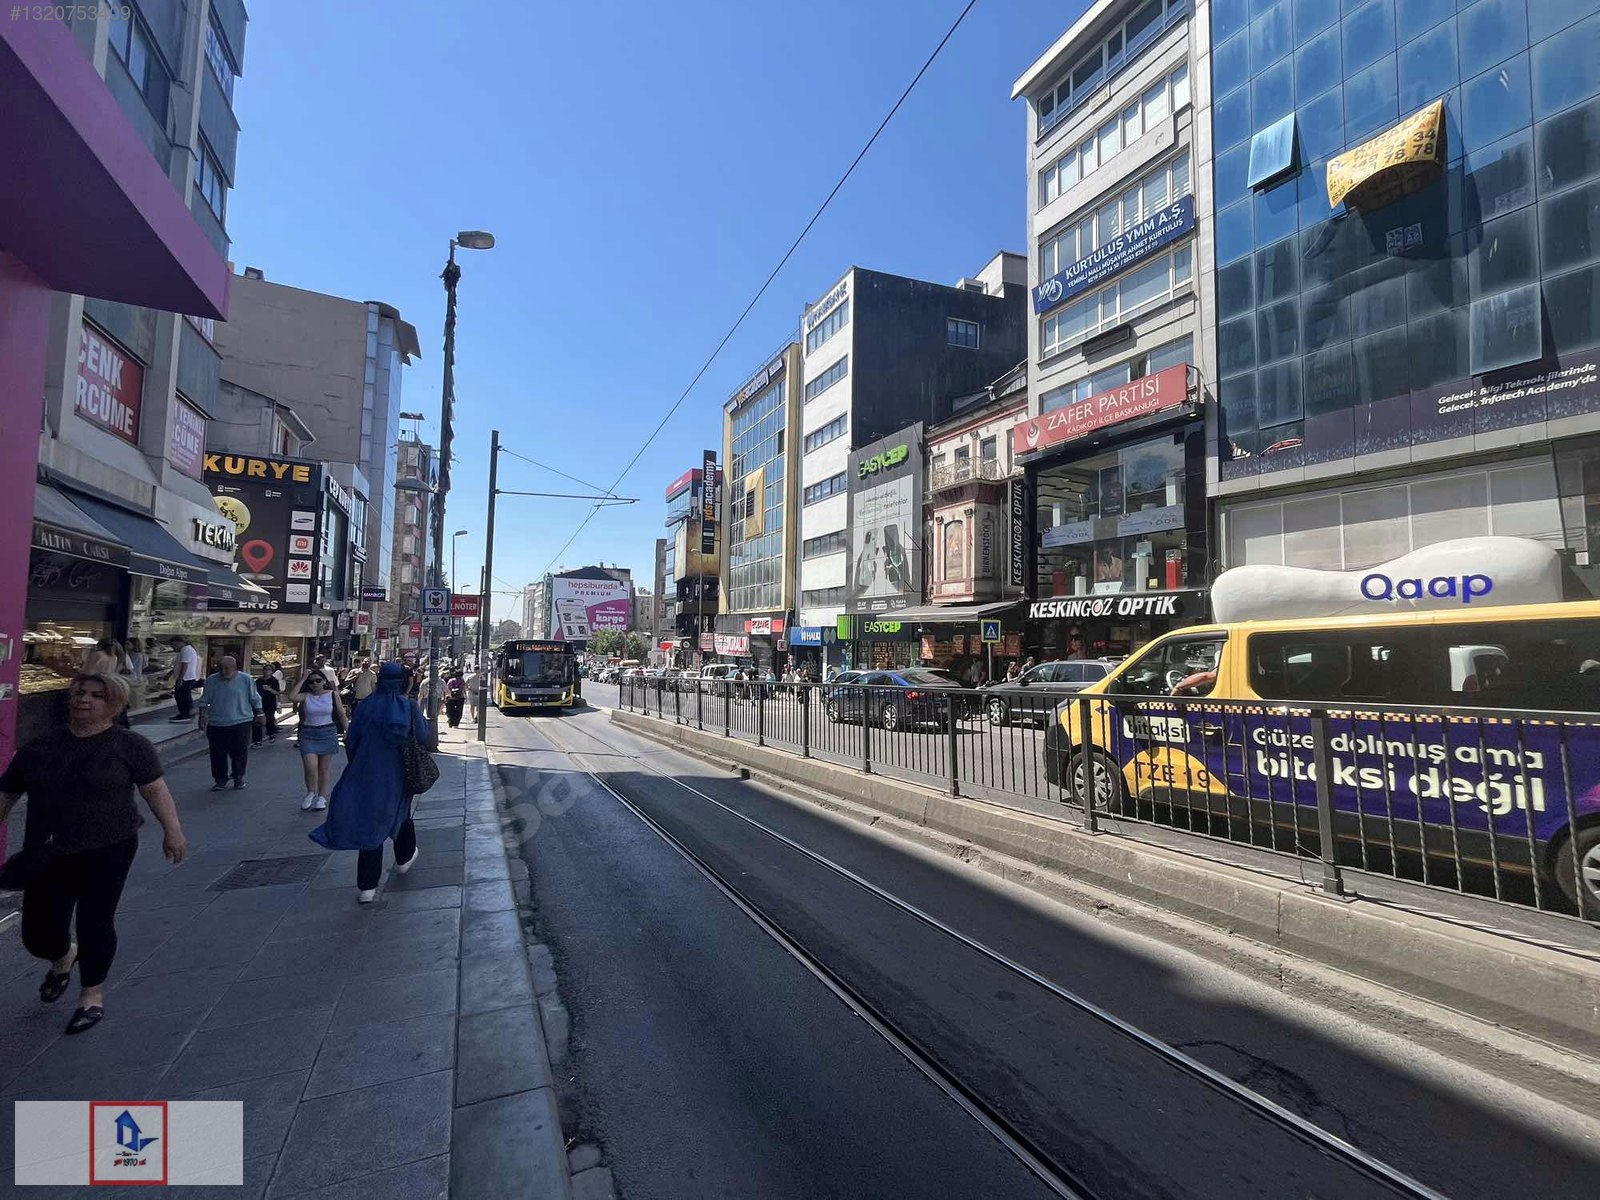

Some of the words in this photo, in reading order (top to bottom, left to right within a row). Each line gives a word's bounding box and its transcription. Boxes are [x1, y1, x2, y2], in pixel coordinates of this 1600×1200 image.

[1413, 128, 1436, 142] 34
[1413, 142, 1434, 155] 78
[1065, 238, 1124, 280] KURTULUŞ
[1126, 221, 1155, 244] YMM
[1158, 203, 1185, 226] A.Ş.
[1125, 239, 1148, 256] AHMET
[1148, 218, 1184, 243] KURTULUŞ
[1479, 384, 1504, 397] Bilgi
[1525, 374, 1598, 397] Academy'de
[1047, 403, 1094, 431] ZAFER
[1099, 374, 1160, 413] PARTİSİ
[1115, 397, 1160, 420] BAŞKANLIĞI
[204, 454, 310, 483] KURYE
[858, 444, 909, 478] EASYCEP
[41, 532, 72, 552] ALTIN
[568, 581, 618, 590] hepsiburada
[1360, 573, 1493, 603] Qaap
[595, 614, 625, 623] kargo
[864, 621, 901, 633] EASYCEP
[1127, 717, 1188, 741] bitaksi
[1252, 727, 1316, 750] Güze
[1330, 732, 1447, 765] dolmuş
[1455, 744, 1544, 769] ama
[1134, 761, 1176, 784] TZE
[1185, 767, 1211, 789] 19
[1408, 767, 1547, 816] değil
